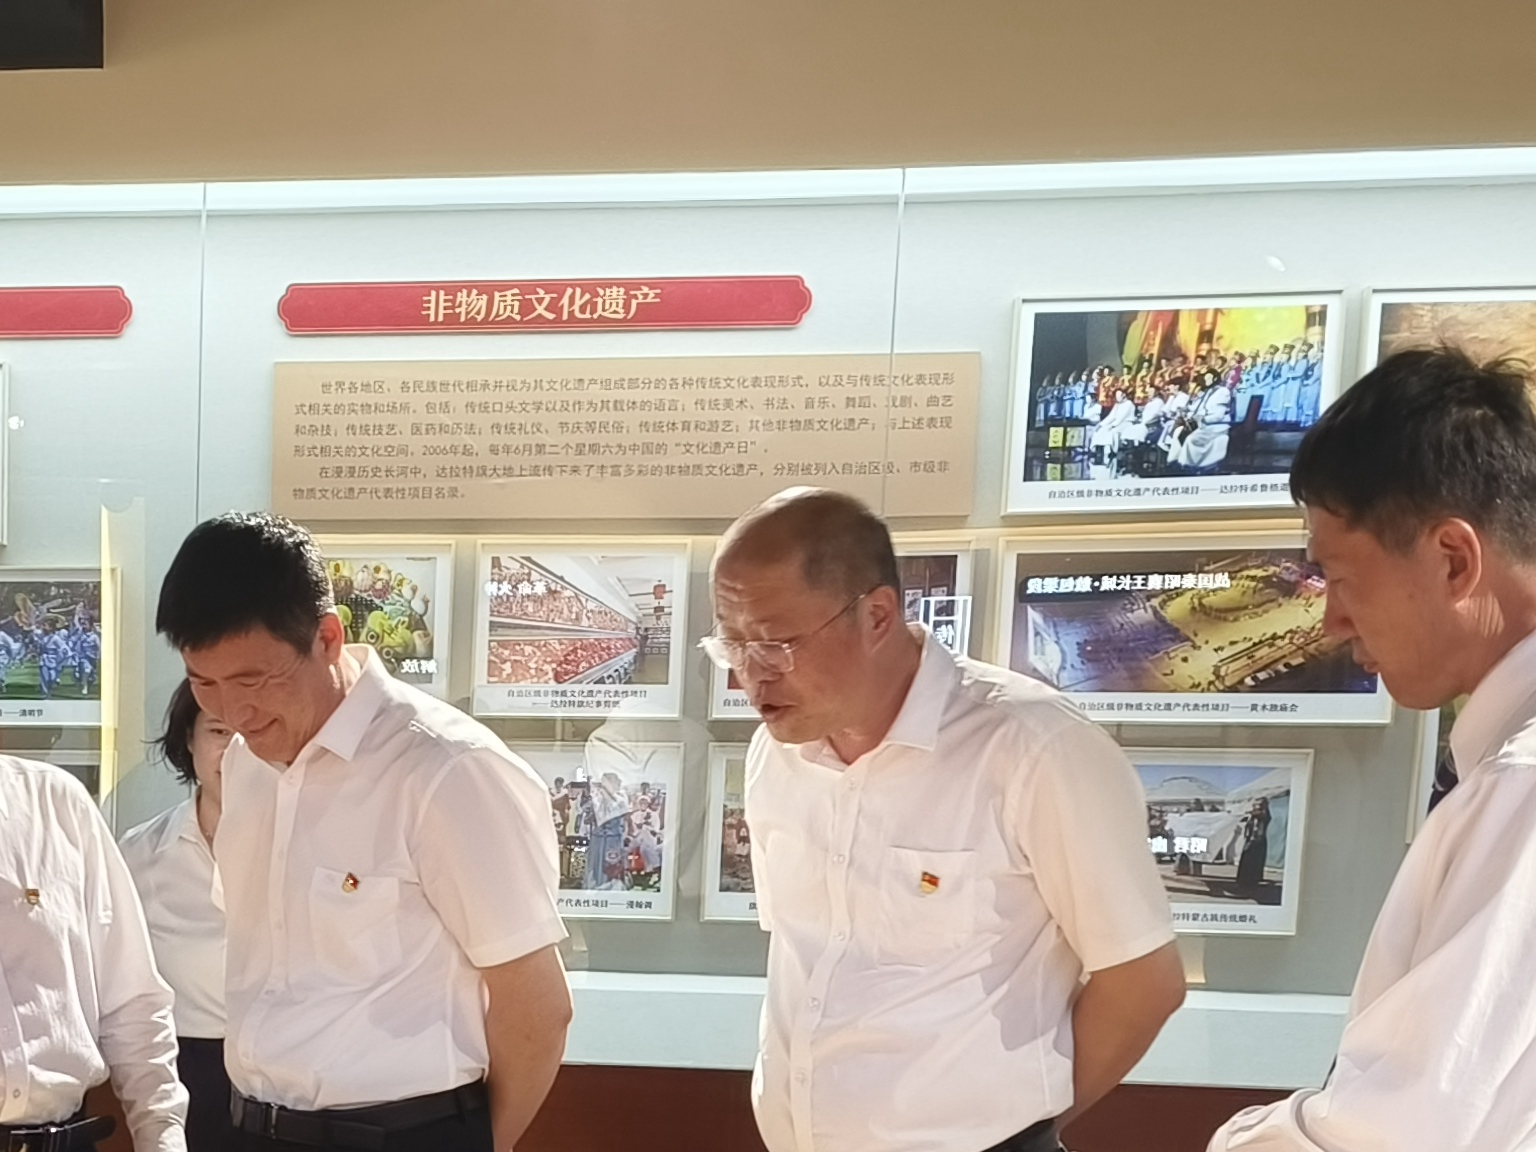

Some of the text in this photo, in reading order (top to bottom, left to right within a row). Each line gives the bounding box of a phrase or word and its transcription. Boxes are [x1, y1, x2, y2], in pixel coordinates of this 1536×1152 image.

[420, 286, 662, 323] 非物质文化遗产
